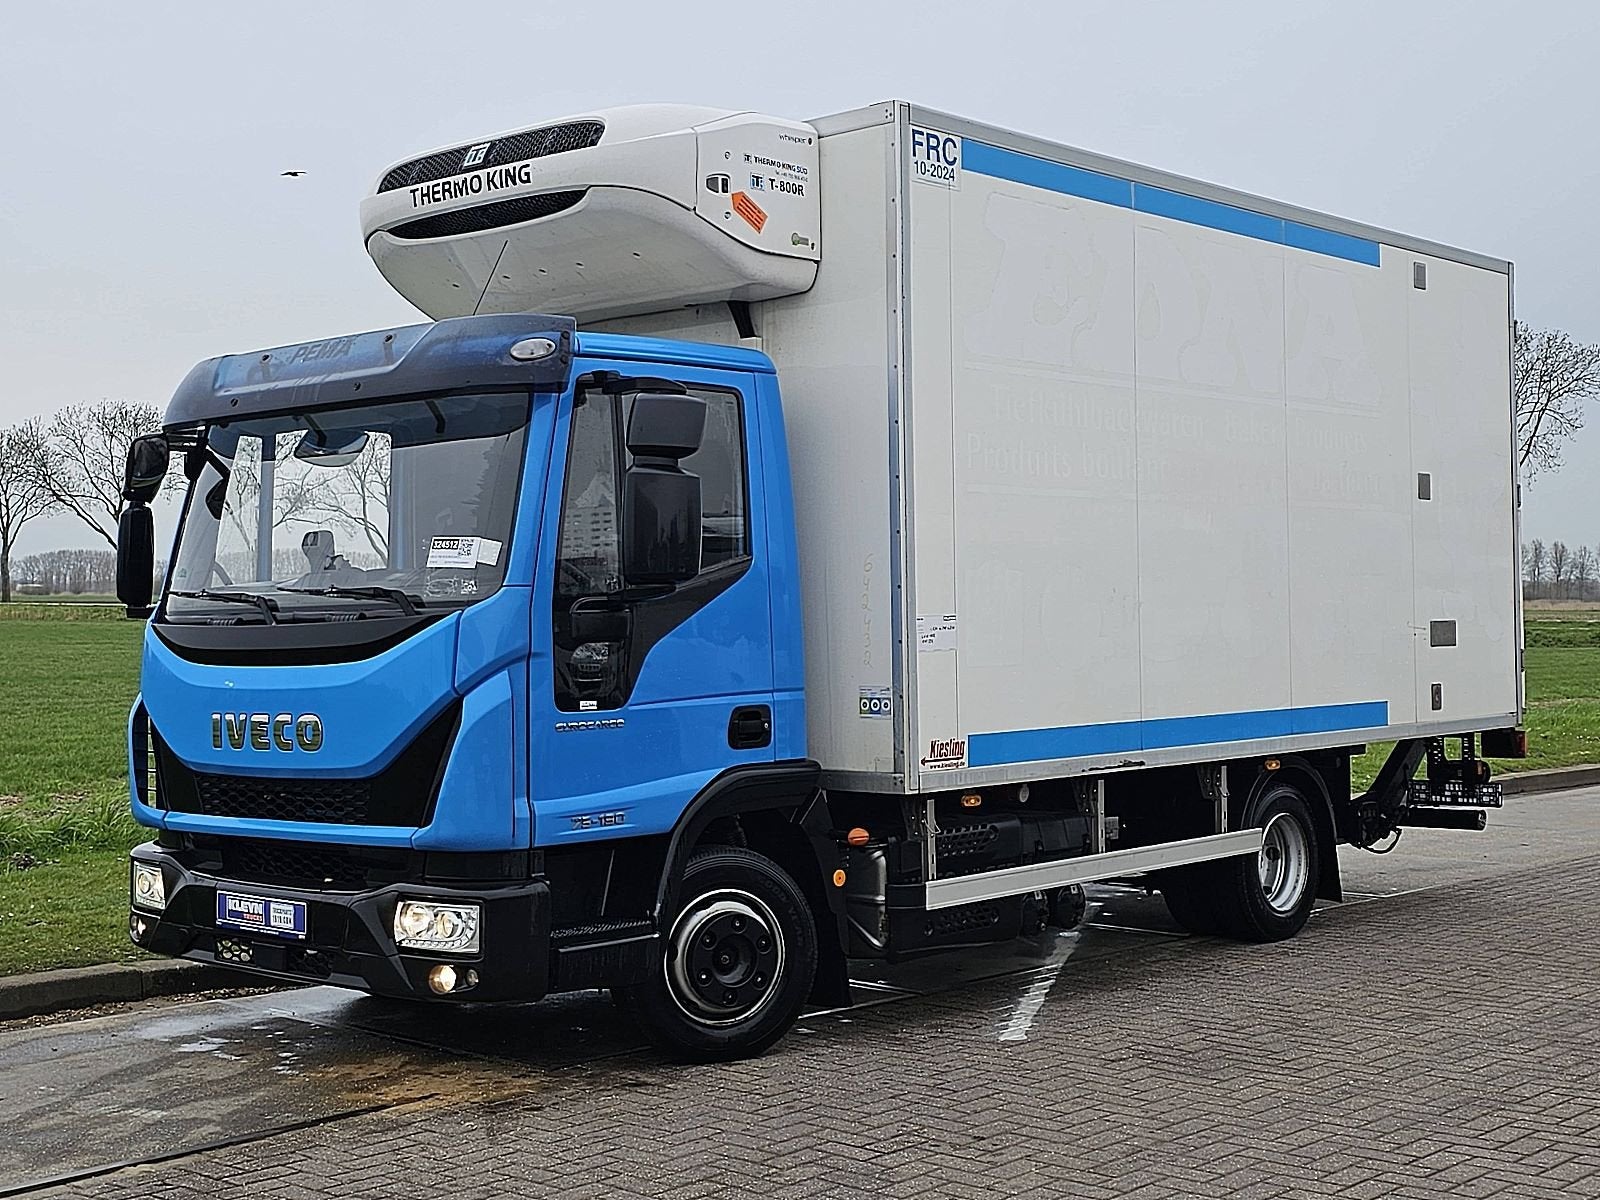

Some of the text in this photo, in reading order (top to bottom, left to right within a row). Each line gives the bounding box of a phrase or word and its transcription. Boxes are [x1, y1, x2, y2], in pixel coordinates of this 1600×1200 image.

[912, 129, 957, 166] FRC
[754, 156, 781, 169] THERMO
[781, 162, 796, 173] KING
[914, 160, 955, 181] 10-2024
[410, 163, 532, 208] THERMO KING
[768, 178, 805, 197] T-800R
[211, 713, 324, 752] IVECO
[555, 719, 625, 732] EUROCARGO
[930, 738, 966, 759] Kiesling
[228, 898, 263, 915] KLEYN
